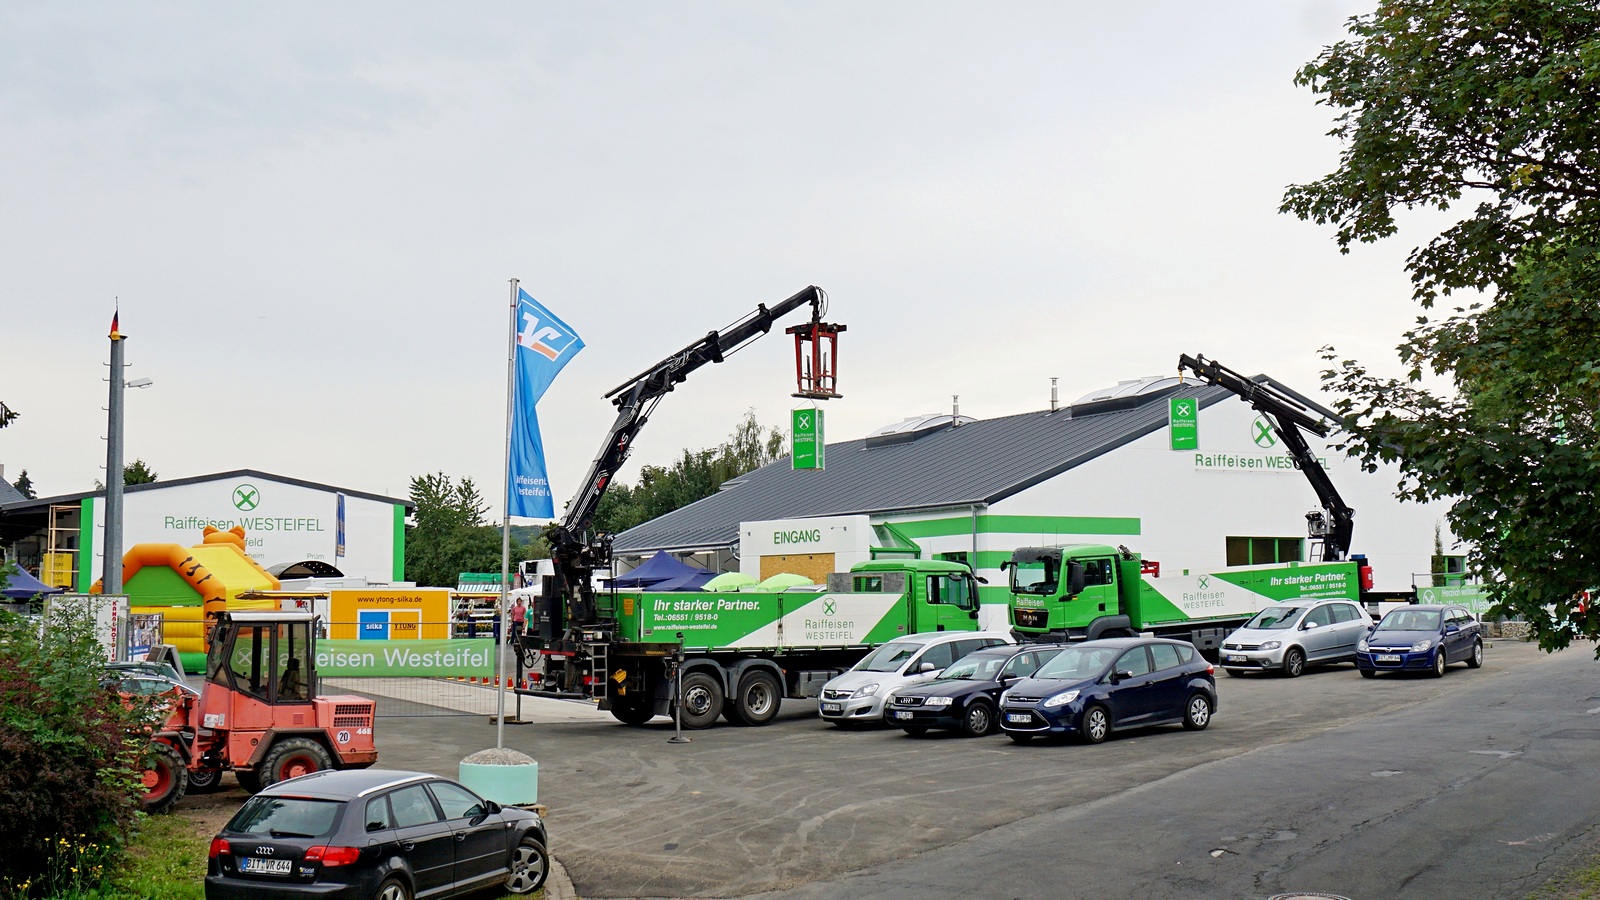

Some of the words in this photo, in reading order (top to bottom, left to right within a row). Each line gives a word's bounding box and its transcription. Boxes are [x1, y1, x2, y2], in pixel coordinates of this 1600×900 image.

[1195, 454, 1263, 468] Raiffeisen
[164, 516, 234, 530] Raiffeisen
[240, 517, 324, 532] WESTEIFEL
[774, 529, 820, 544] EINGANG
[246, 538, 263, 547] feld
[1270, 577, 1284, 586] Ihr
[1284, 574, 1313, 585] starker
[1315, 573, 1346, 582] Partner.
[357, 596, 422, 604] www.ytong-silka.de
[1016, 597, 1044, 606] Raiffeisen
[1183, 592, 1225, 600] Raiffeisen
[654, 599, 671, 611] Ihr
[673, 599, 714, 610] starker
[716, 599, 760, 610] Partner.
[1184, 600, 1225, 609] WESTEIFEL
[805, 620, 854, 629] Raiffeisen
[384, 648, 488, 667] Westeifel
[339, 732, 349, 742] 20
[247, 859, 261, 868] BIT
[266, 860, 275, 870] VR
[276, 861, 290, 871] 644
